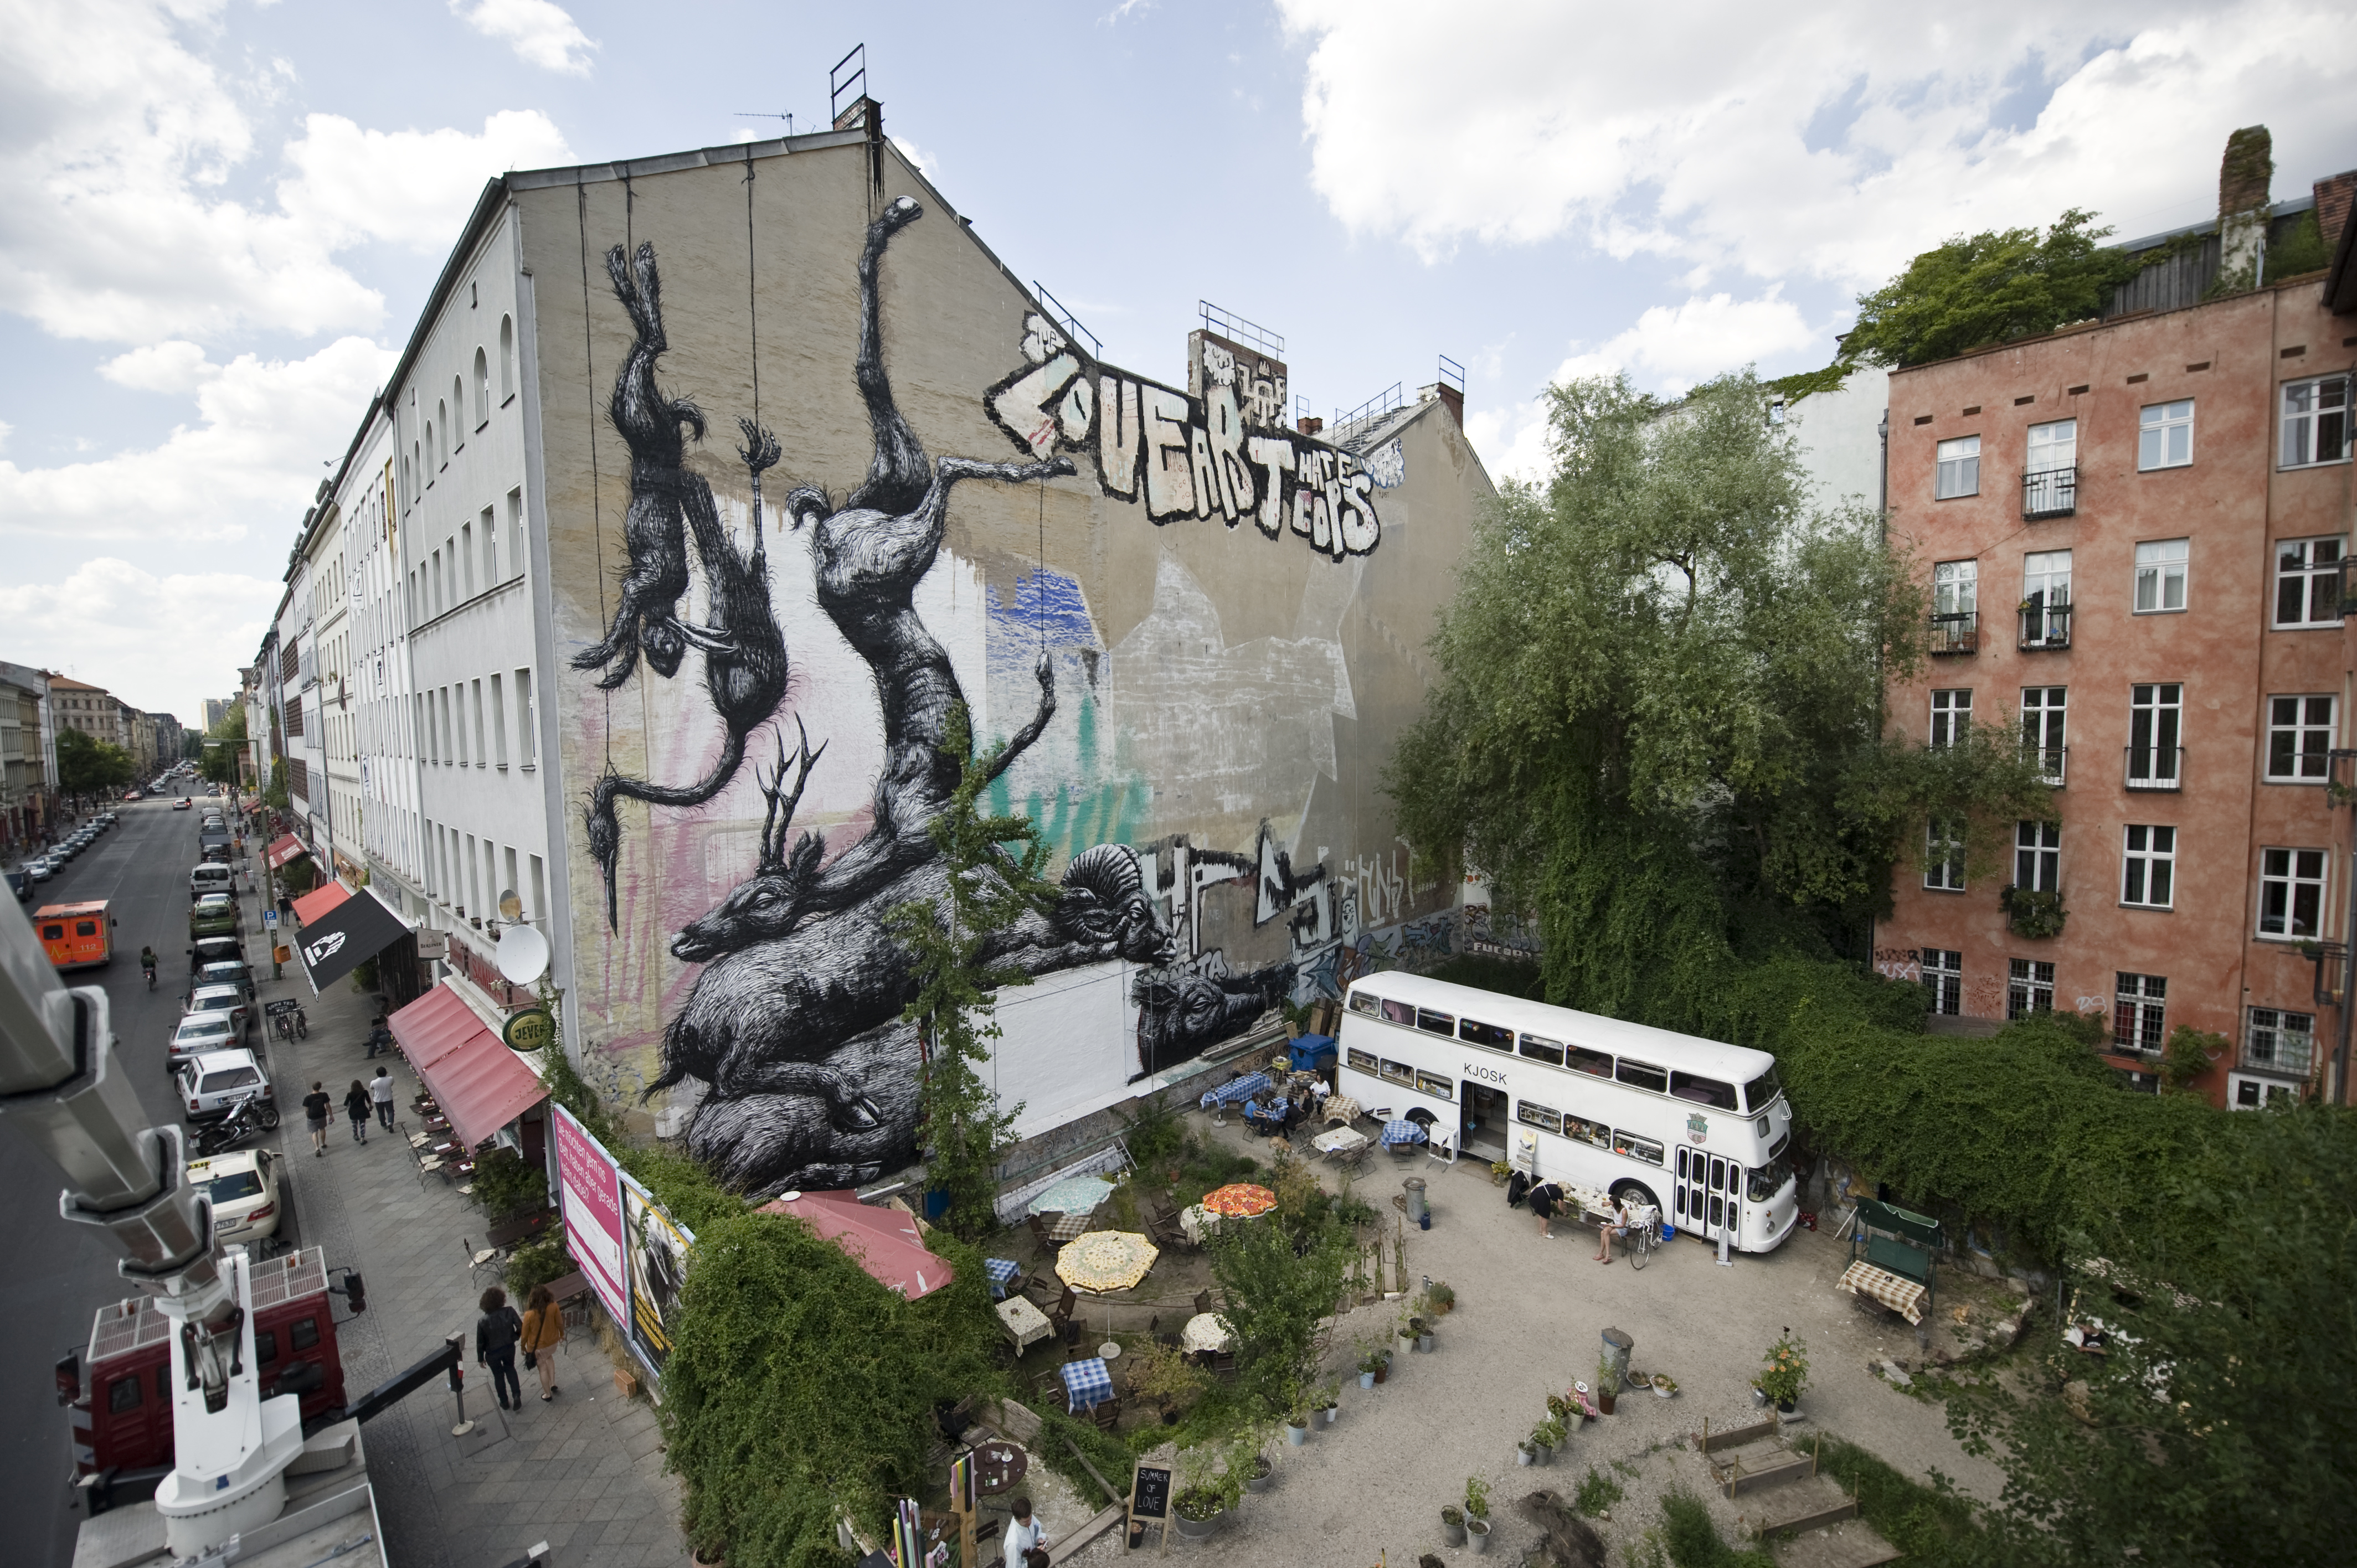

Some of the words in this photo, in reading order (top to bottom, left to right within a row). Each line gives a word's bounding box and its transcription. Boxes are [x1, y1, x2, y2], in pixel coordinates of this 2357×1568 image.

[1037, 327, 1057, 347] 1UP
[1299, 449, 1352, 492] HATE
[1291, 472, 1381, 563] COPS
[1464, 1062, 1507, 1085] KJOSK
[1519, 1108, 1532, 1121] EIS
[557, 1117, 565, 1138] Sie
[565, 1129, 585, 1160] möchten
[586, 1151, 598, 1174] gern
[598, 1160, 606, 1183] ins
[558, 1137, 569, 1163] Bett,
[569, 1149, 585, 1179] haben
[585, 1169, 597, 1193] aber
[597, 1185, 618, 1216] gerade
[560, 1157, 573, 1184] keins
[573, 1174, 589, 1204] dabei?
[605, 1257, 622, 1286] 11833
[1140, 1469, 1168, 1482] SUMMER
[1146, 1484, 1156, 1493] OF
[1138, 1495, 1161, 1510] LOVE
